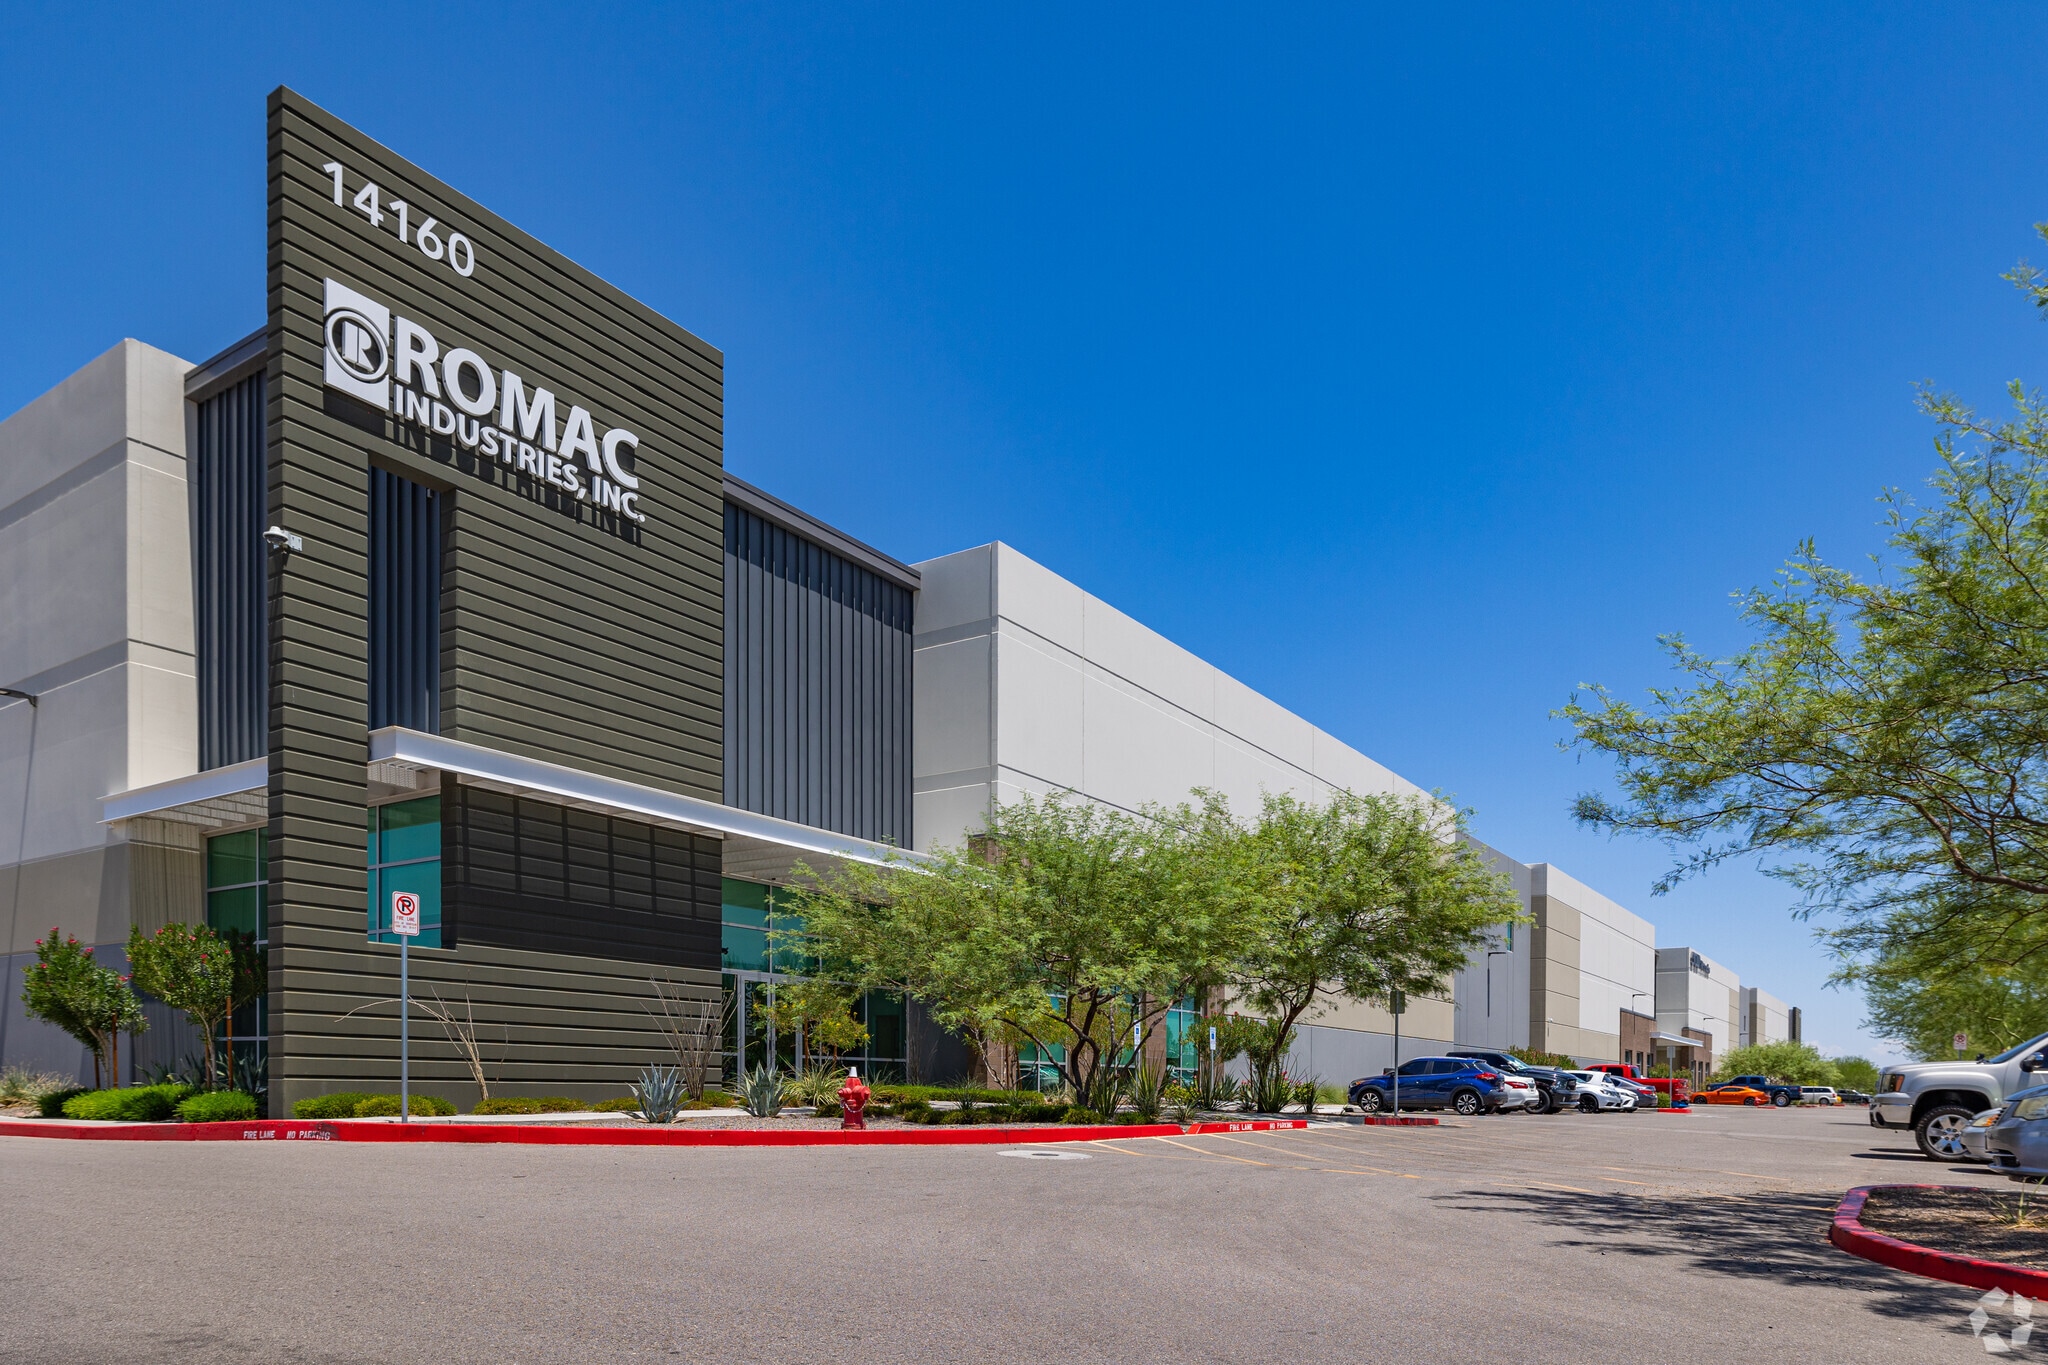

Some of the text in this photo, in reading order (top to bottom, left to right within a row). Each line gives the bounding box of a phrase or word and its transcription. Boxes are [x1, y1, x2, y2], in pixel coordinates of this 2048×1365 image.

[323, 161, 474, 277] 14160
[394, 316, 639, 489] ROMAC
[394, 384, 646, 523] INDUSTRIES, INC.
[244, 1130, 331, 1140] FIRE LANE NO PARKING
